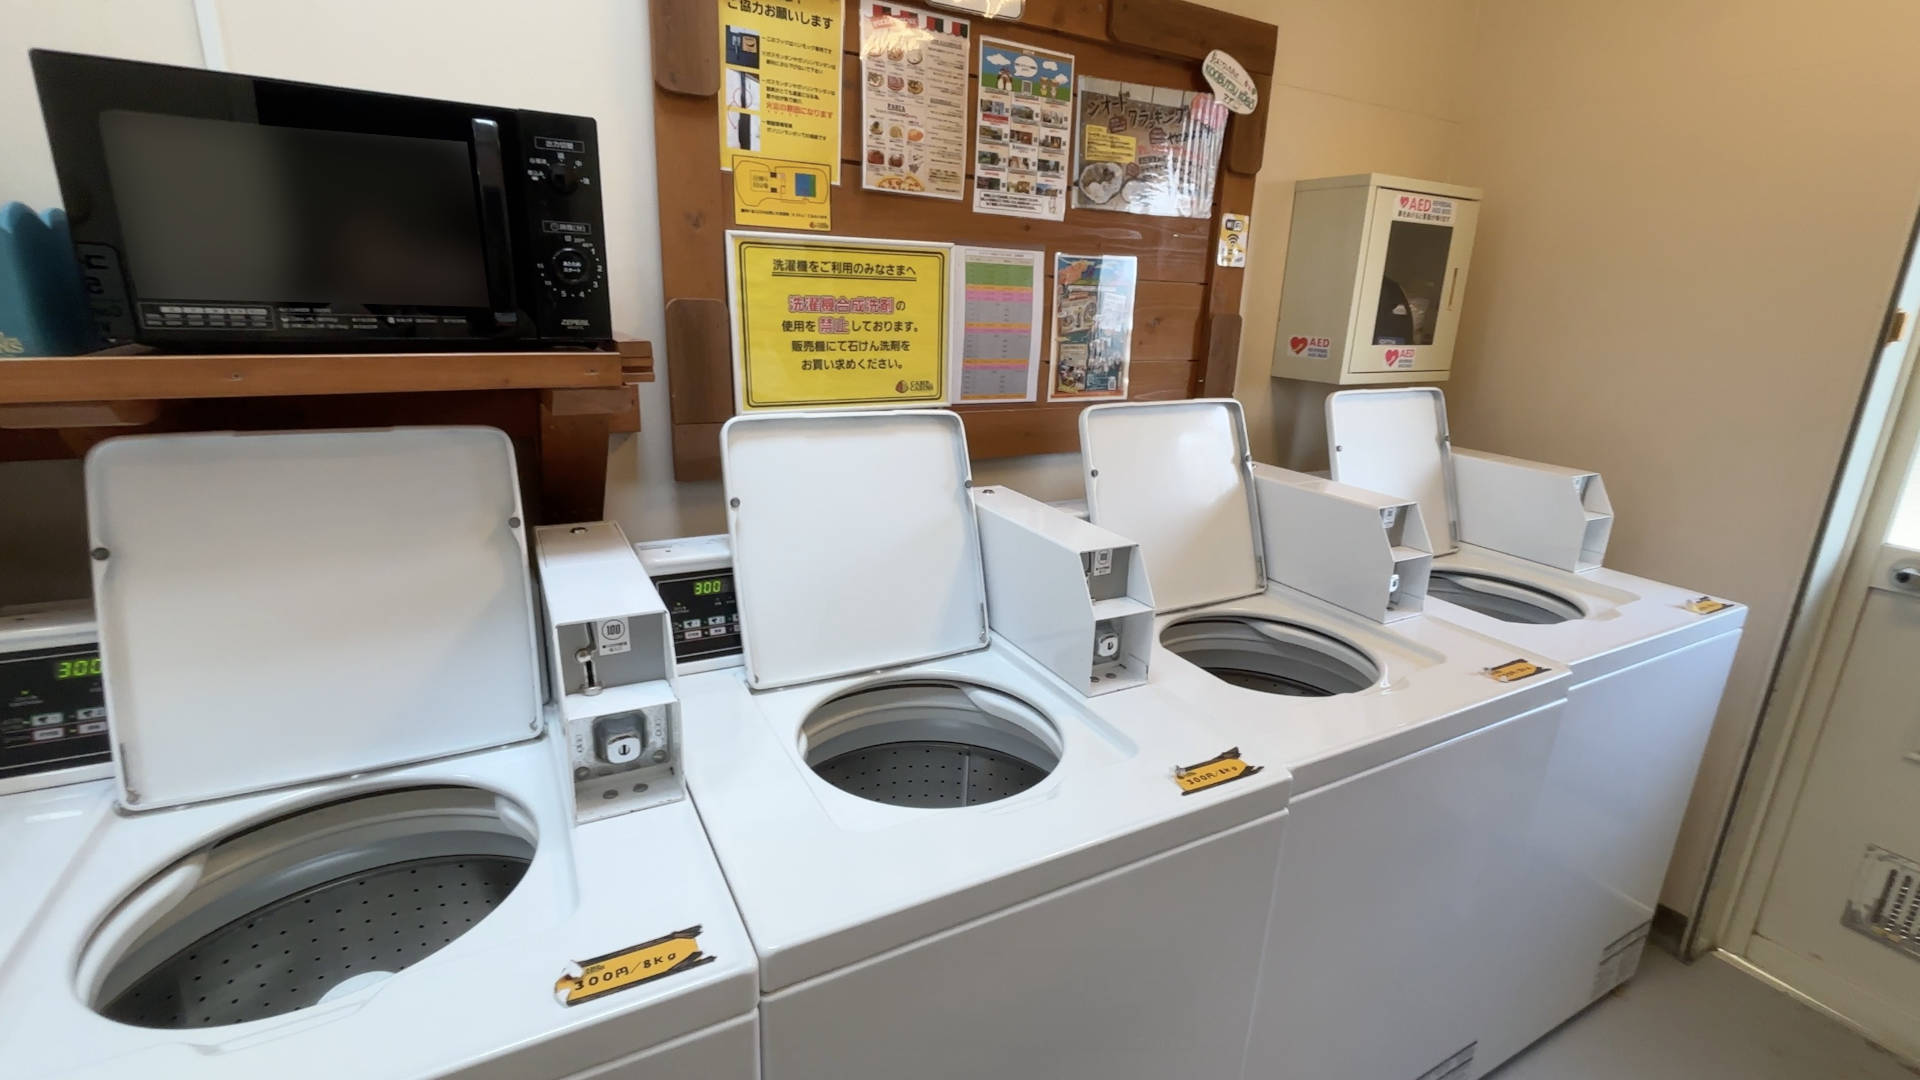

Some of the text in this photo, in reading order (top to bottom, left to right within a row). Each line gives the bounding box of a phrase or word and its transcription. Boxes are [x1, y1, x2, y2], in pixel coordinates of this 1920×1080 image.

[1408, 197, 1432, 212] AED
[772, 258, 917, 277] 洗濯機をご利用のみなさまへ
[781, 316, 919, 334] 使用を禁止しております。
[791, 340, 911, 353] 販売機にて石けん洗剤を
[1309, 338, 1330, 348] AED
[1400, 348, 1415, 358] AED
[801, 358, 904, 371] お買い求めください。
[695, 580, 721, 595] 300
[606, 624, 621, 635] 100
[58, 659, 101, 679] 300
